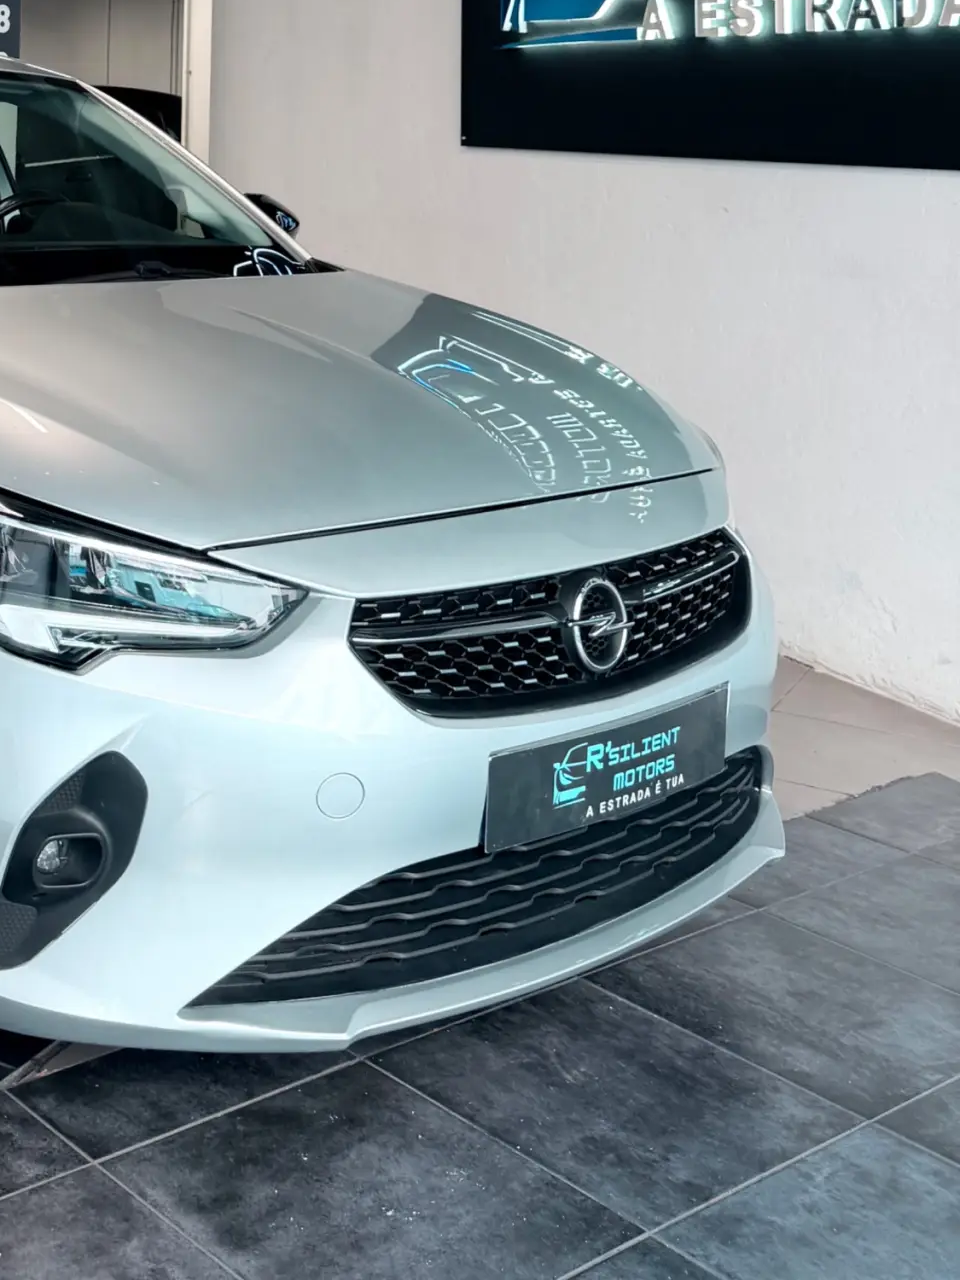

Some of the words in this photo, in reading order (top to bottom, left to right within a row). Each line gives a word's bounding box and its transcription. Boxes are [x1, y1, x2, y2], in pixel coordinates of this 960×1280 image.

[585, 726, 681, 772] R'SILIENT
[612, 753, 676, 792] MOTORS
[585, 805, 594, 818] A
[598, 789, 651, 814] ESTRADA
[665, 773, 685, 791] TUA
